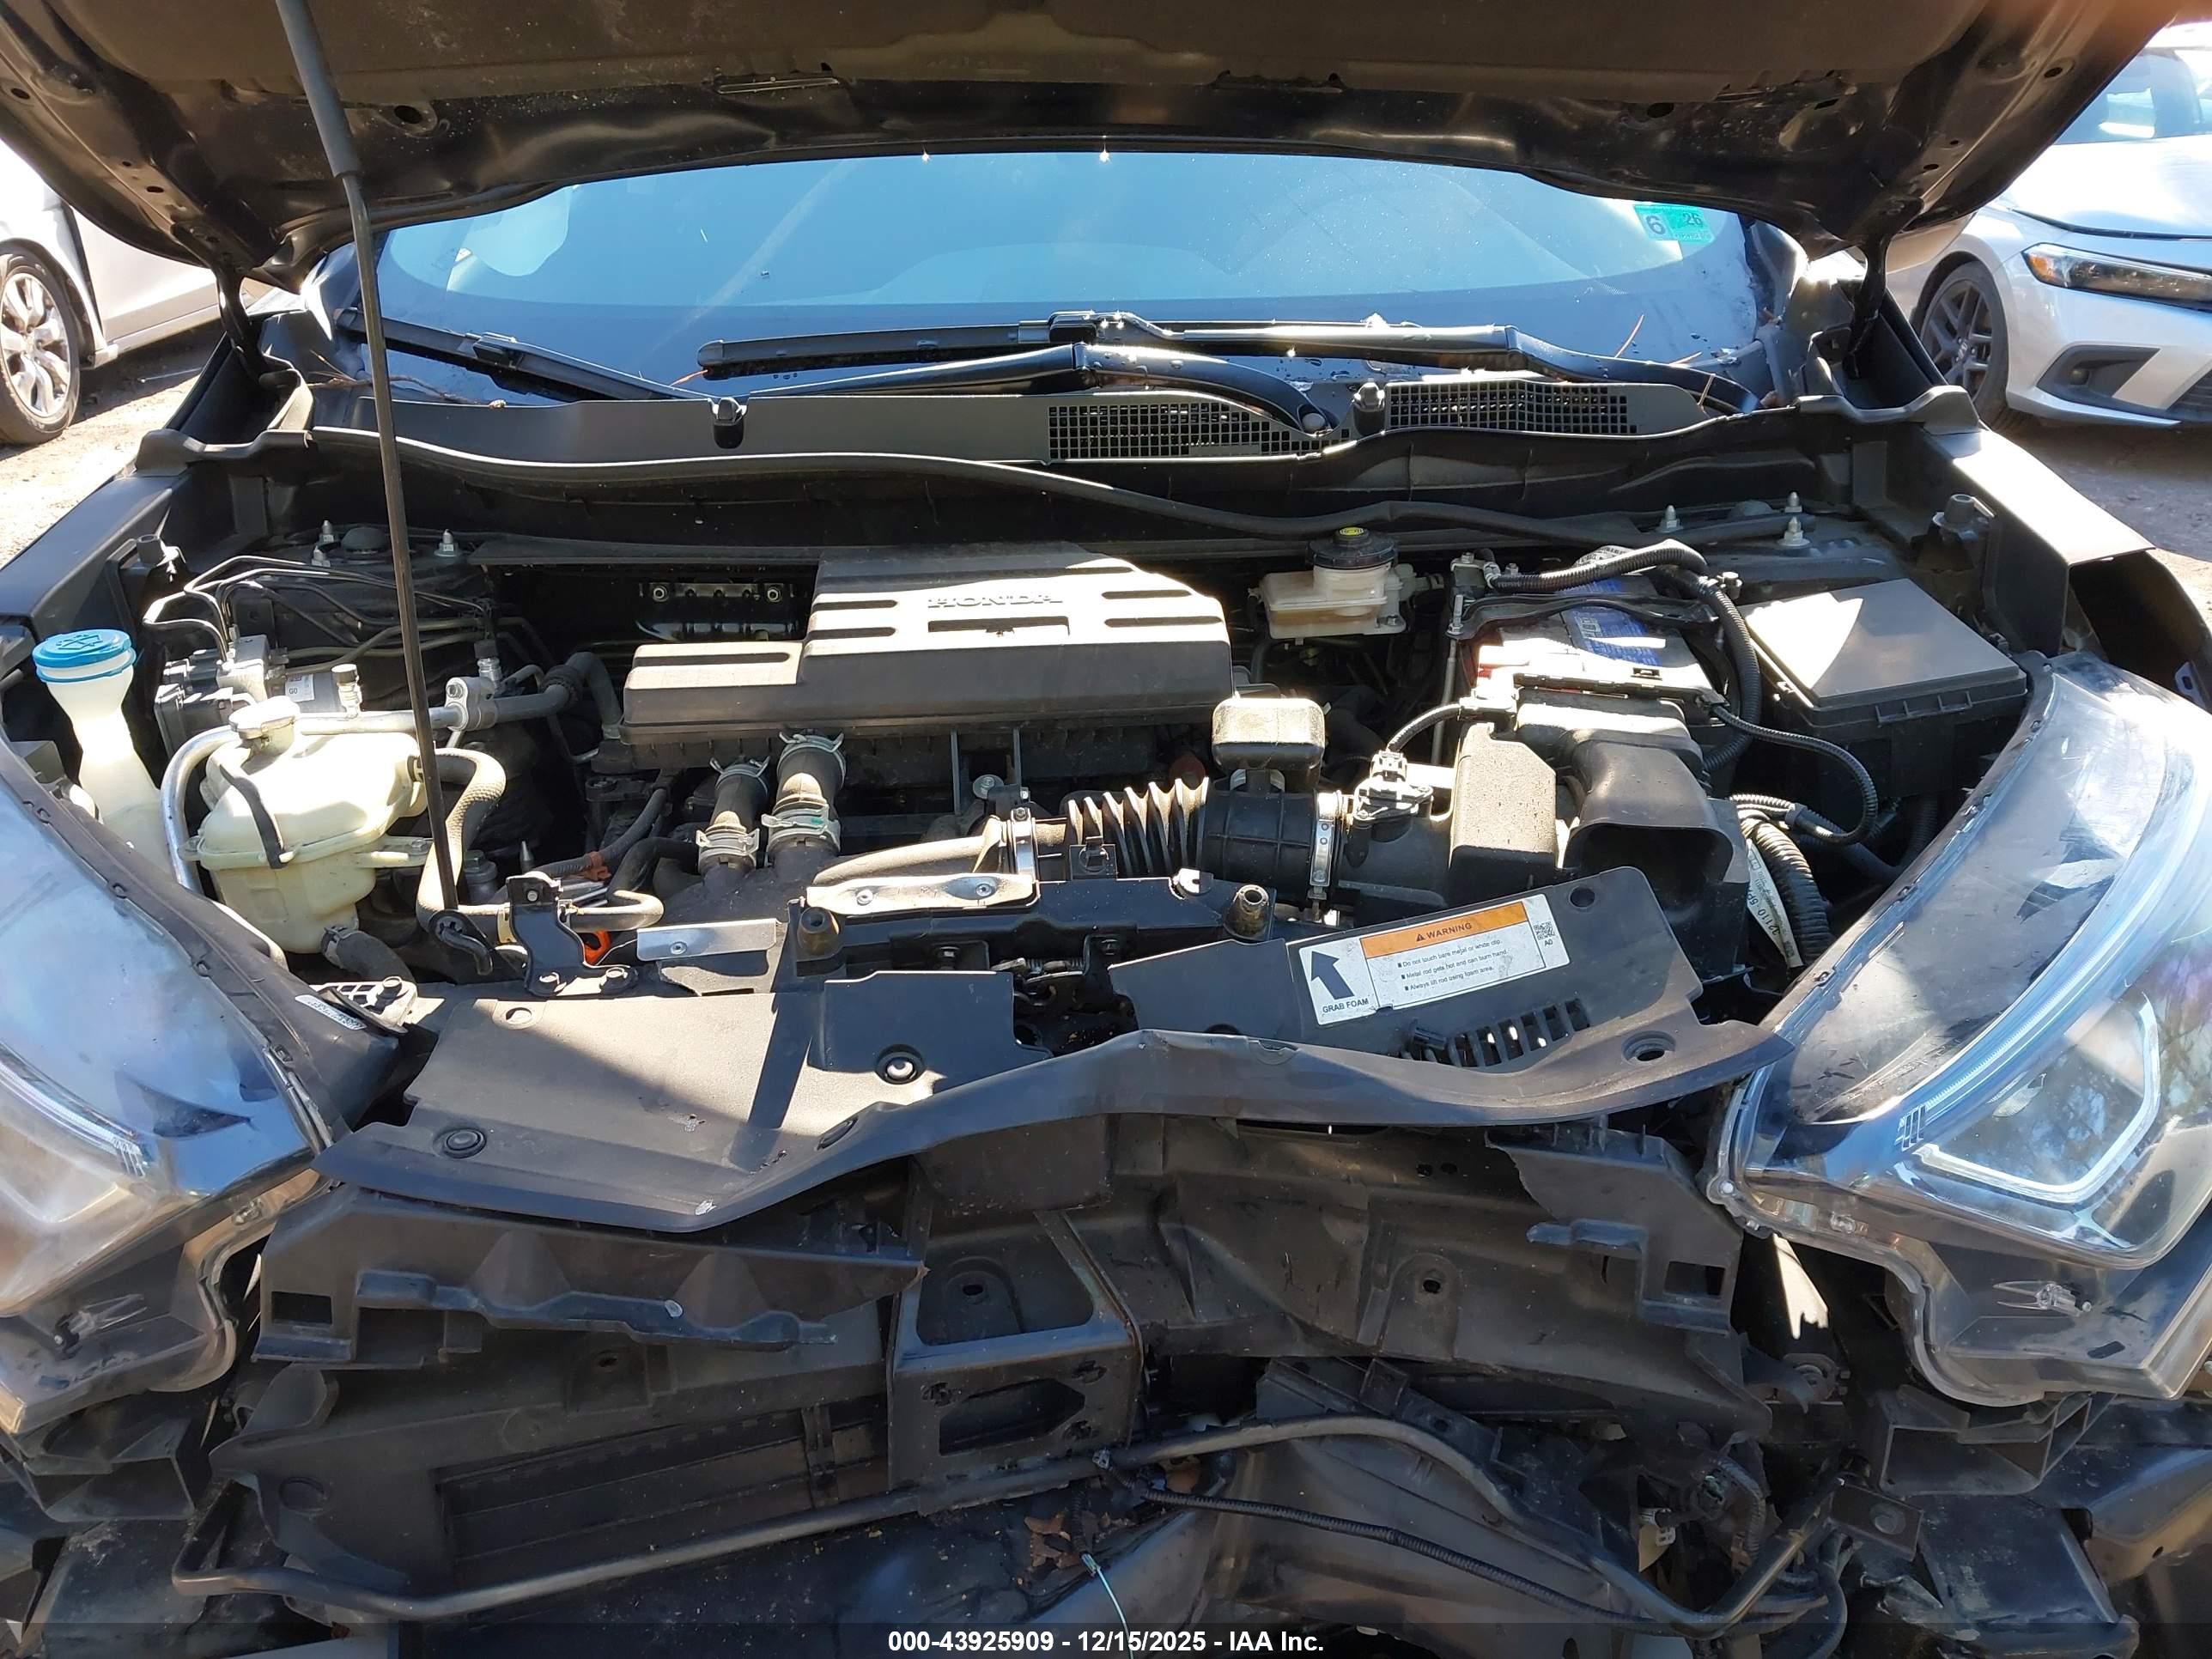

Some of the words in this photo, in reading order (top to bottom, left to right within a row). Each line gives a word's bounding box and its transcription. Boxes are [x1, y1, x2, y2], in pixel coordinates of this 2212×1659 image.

[1645, 215, 1666, 235] 6
[927, 593, 1064, 609] HONDA
[1425, 922, 1473, 939] WARNING
[1402, 958, 1411, 967] Do
[1421, 954, 1437, 963] touch
[1451, 946, 1467, 955] metal
[1406, 970, 1421, 979] Metal
[1432, 965, 1445, 974] gets
[1410, 981, 1430, 991] Always
[1448, 973, 1463, 981] using
[1463, 969, 1479, 977] foam
[1322, 1000, 1346, 1013] GRAB
[1346, 998, 1370, 1009] FOAM
